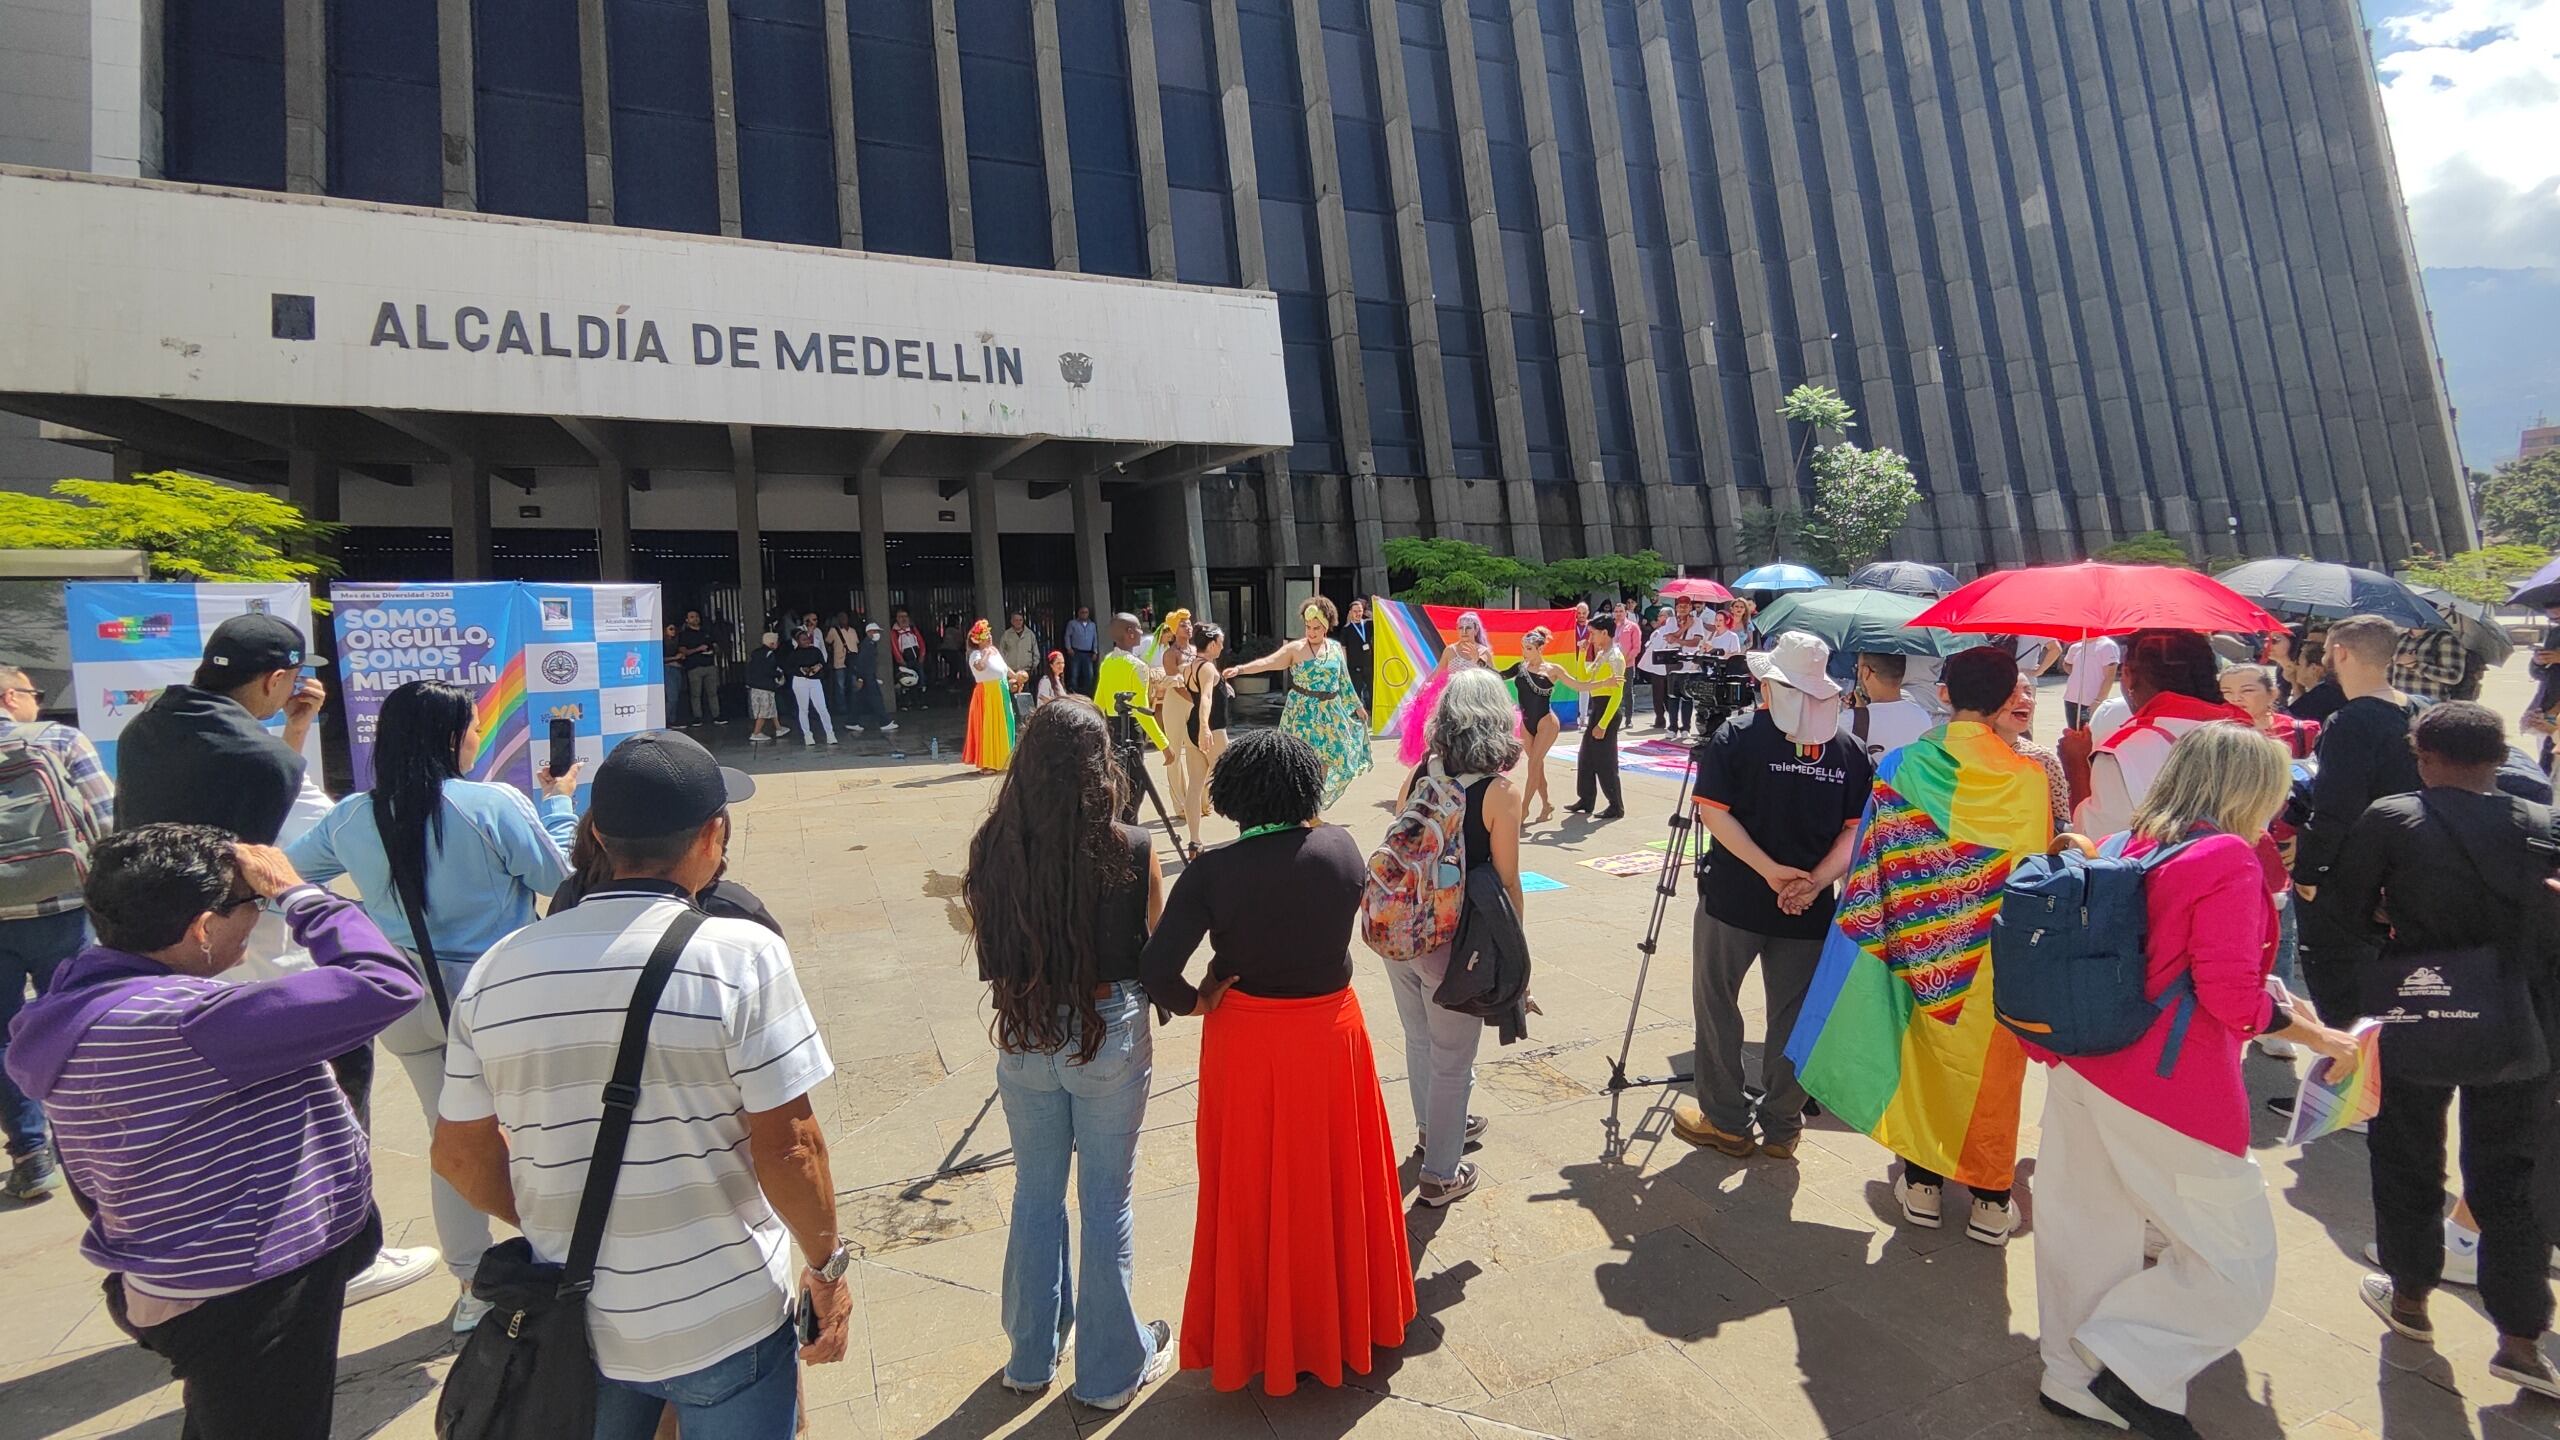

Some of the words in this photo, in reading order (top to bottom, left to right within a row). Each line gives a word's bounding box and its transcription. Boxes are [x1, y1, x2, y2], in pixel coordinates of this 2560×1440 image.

[370, 302, 669, 364] ALCALDÍA
[692, 323, 760, 369] DE
[382, 591, 425, 599] Diversidad
[344, 607, 457, 629] SOMOS
[346, 626, 496, 650] ORGULLO,
[350, 646, 462, 670] SOMOS
[352, 662, 497, 692] MEDELLÍN
